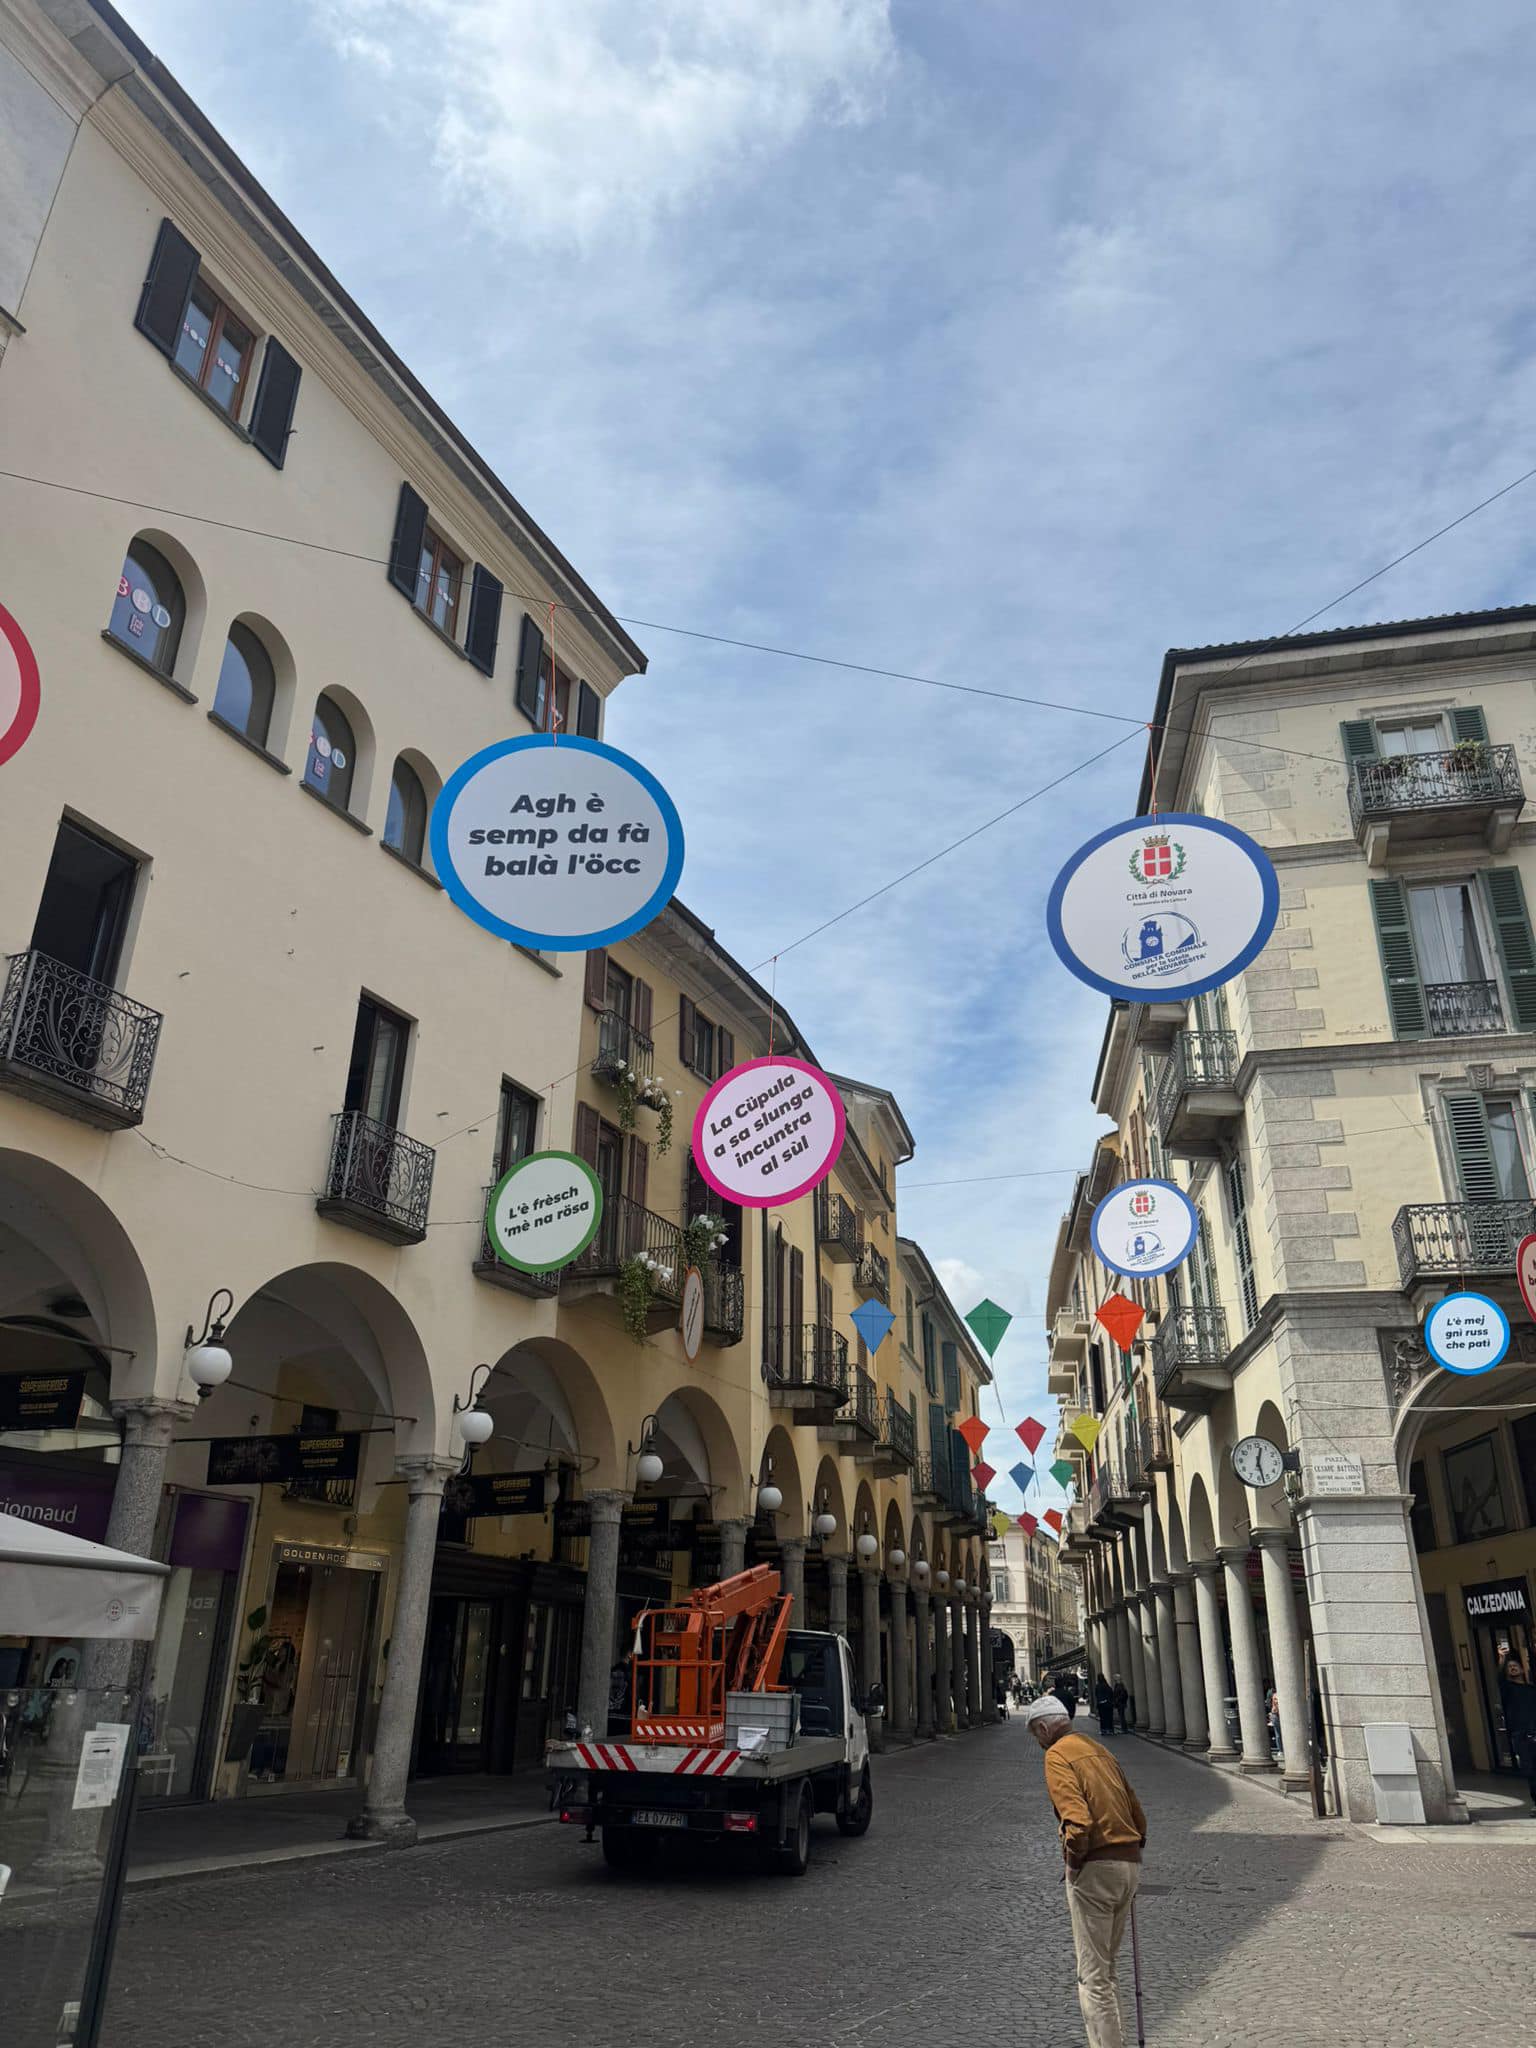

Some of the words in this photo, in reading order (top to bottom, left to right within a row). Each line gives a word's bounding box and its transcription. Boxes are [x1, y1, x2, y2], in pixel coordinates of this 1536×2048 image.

[510, 793, 576, 818] Agh
[586, 792, 605, 813] è
[468, 826, 558, 848] semp
[568, 823, 608, 844] da
[617, 822, 650, 843] fà
[484, 855, 557, 877] balà
[568, 853, 641, 875] l'öcc
[1126, 892, 1147, 902] Città
[1149, 891, 1158, 899] di
[1160, 888, 1193, 898] Novara
[1124, 953, 1164, 971] CONSULTA
[1164, 940, 1208, 958] COMUNALE
[1145, 962, 1158, 971] per
[1158, 958, 1167, 966] la
[1167, 952, 1190, 964] tutela
[1132, 967, 1156, 980] DELLA
[710, 1115, 732, 1136] La
[735, 1073, 796, 1119] Cüpula
[713, 1143, 727, 1158] a
[729, 1127, 751, 1148] sa
[753, 1086, 814, 1132] slunga
[734, 1111, 812, 1169] incuntra
[761, 1155, 779, 1175] al
[509, 1202, 529, 1219] L'è
[532, 1185, 579, 1211] frèsch
[504, 1219, 531, 1238] 'mè
[534, 1213, 553, 1228] na
[557, 1200, 590, 1219] rösa
[1446, 1316, 1462, 1326] L'è
[1464, 1314, 1485, 1326] mej
[1465, 1328, 1489, 1337] russ
[1446, 1340, 1466, 1350] che
[0, 1497, 78, 1524] ionnaud
[283, 1548, 326, 1561] GOLDEN
[1466, 1590, 1526, 1616] CALZEDONIA
